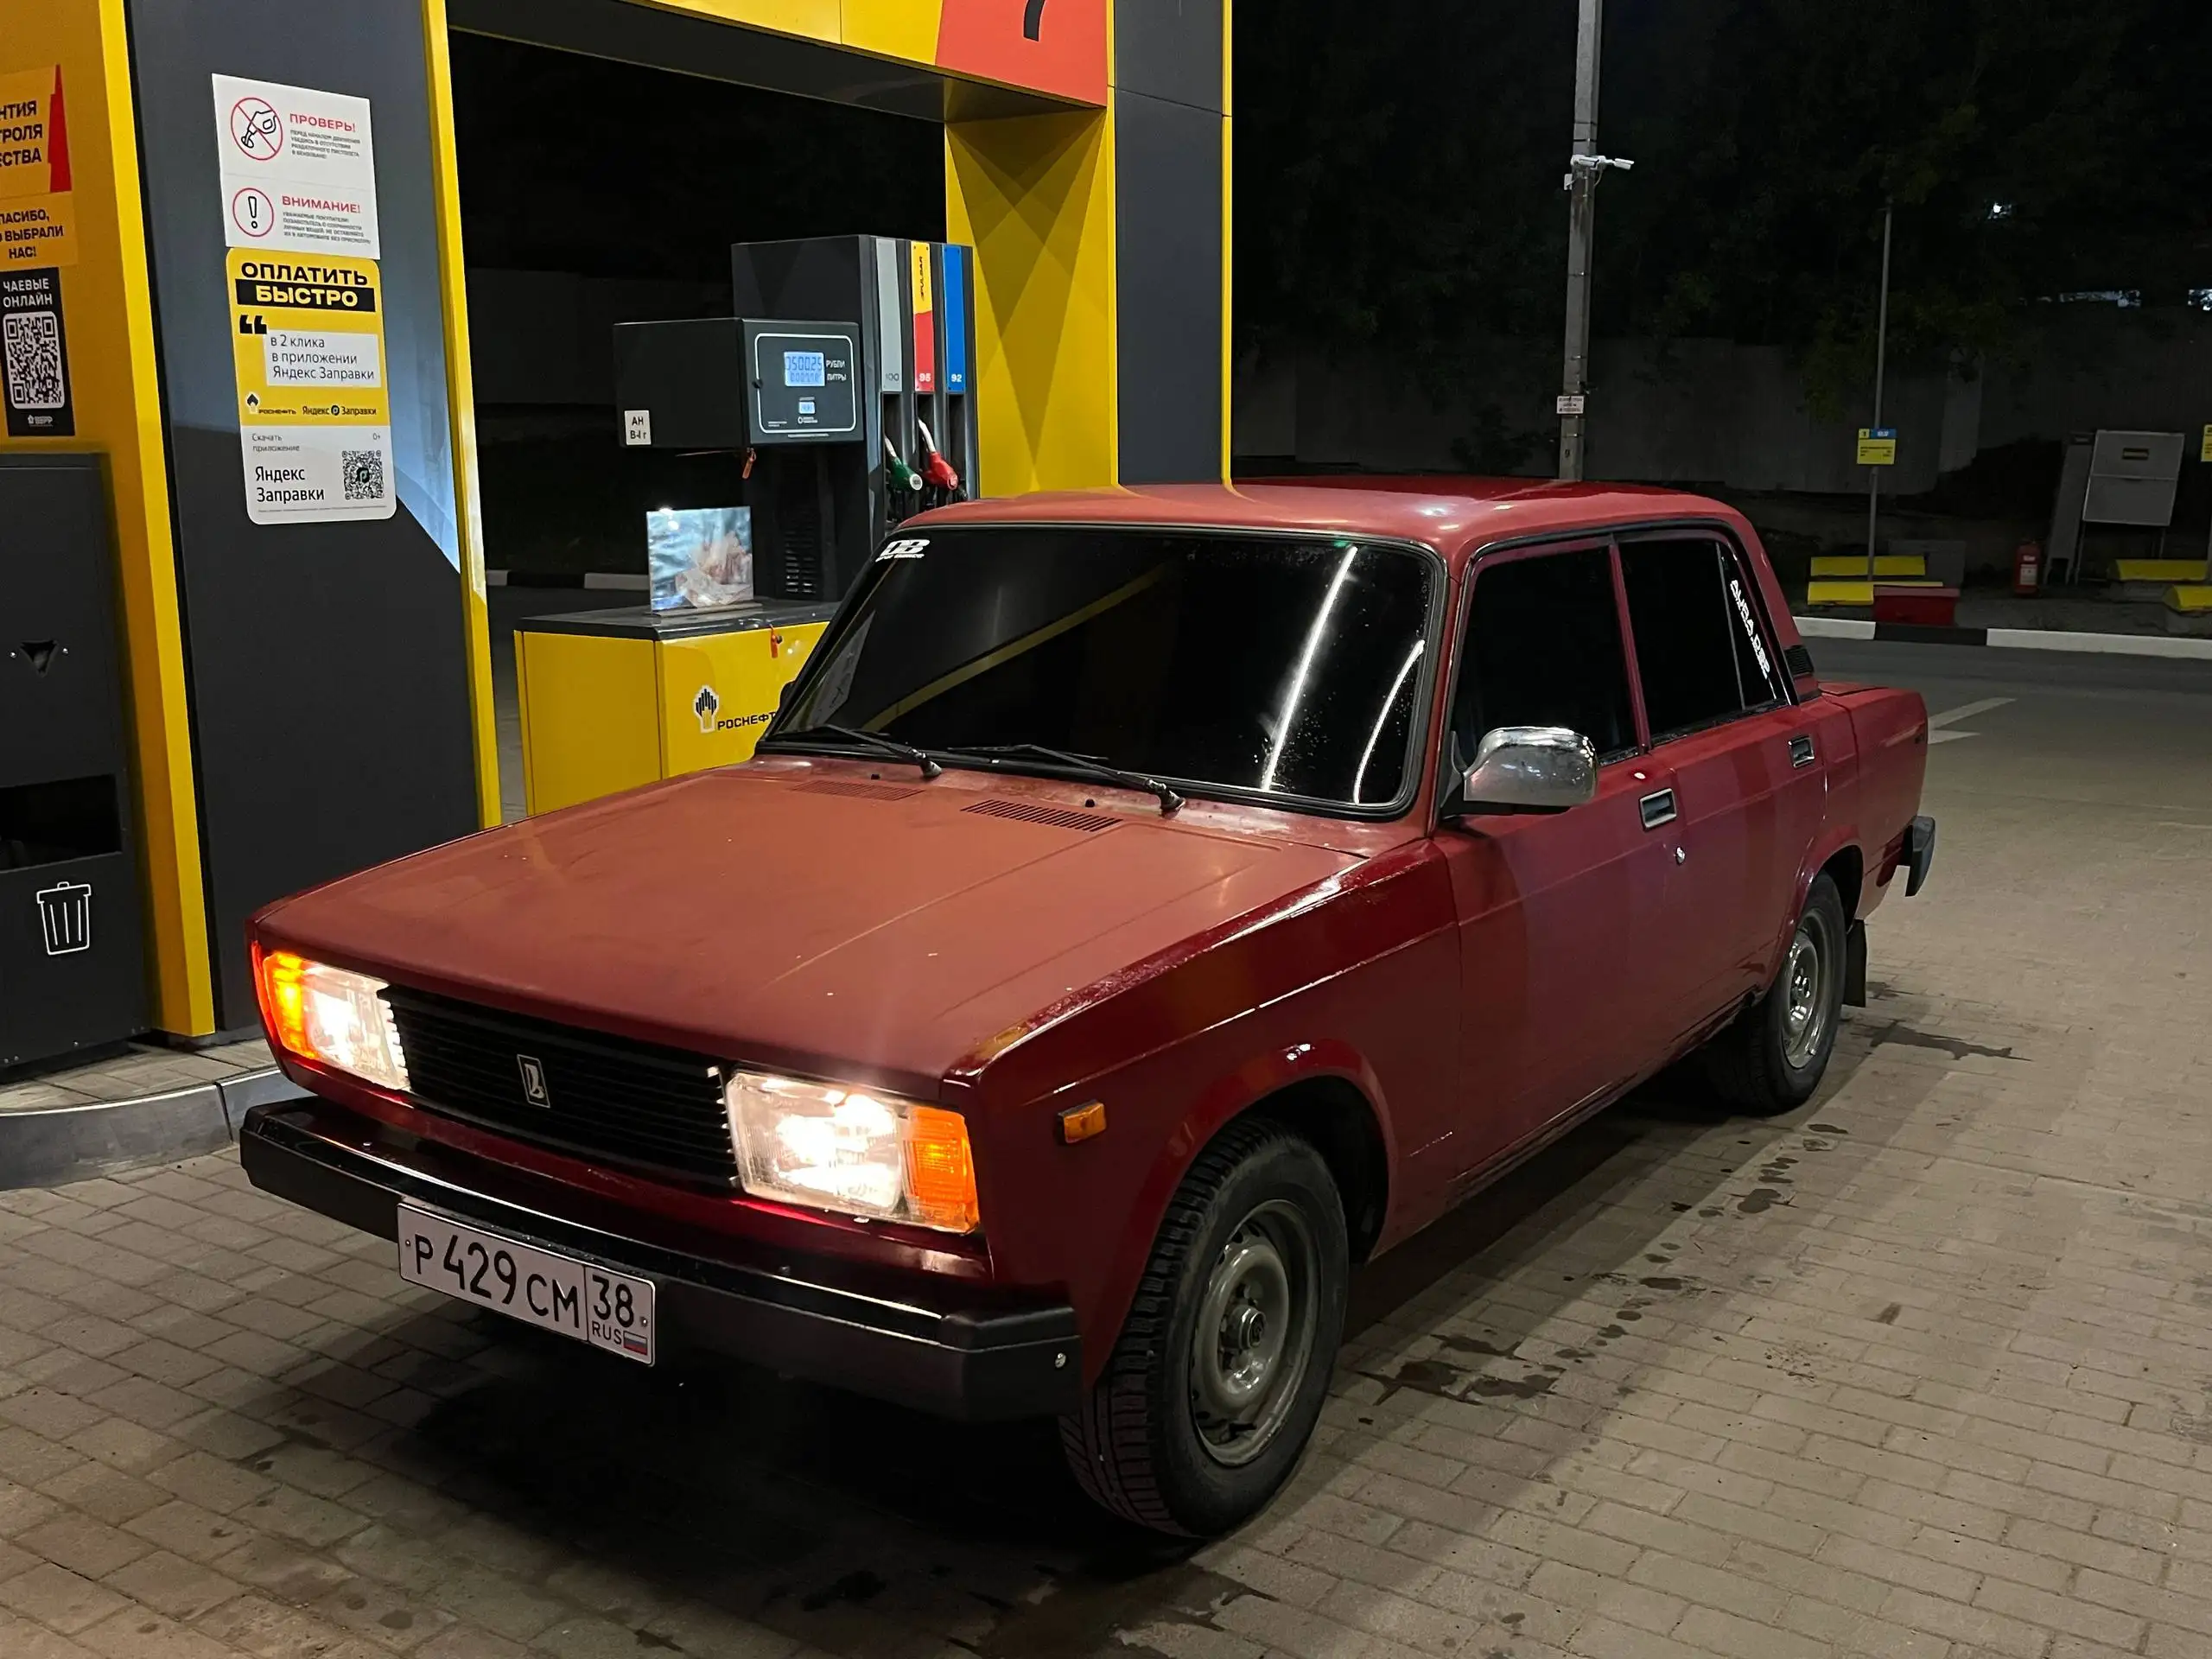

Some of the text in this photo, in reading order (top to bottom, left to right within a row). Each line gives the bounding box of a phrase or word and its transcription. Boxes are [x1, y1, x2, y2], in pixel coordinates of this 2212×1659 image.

[289, 113, 356, 132] ПРОВЕРЬ!
[0, 124, 42, 143] РОЛЯ
[282, 196, 360, 213] ВНИМАНИЕ!
[4, 226, 64, 242] ВЫБРАЛИ
[9, 246, 36, 258] НАС!
[241, 263, 368, 286] ОПЛАТИТЬ
[3, 278, 49, 292] ЧАЕВЫЕ
[3, 291, 53, 308] ОНЛАЙН
[256, 285, 358, 307] БЫСТРО
[270, 334, 325, 348] в 2 клика
[272, 353, 357, 365] в приложении
[273, 365, 374, 382] Яндекс Заправки
[302, 406, 329, 415] Яндекс
[341, 407, 377, 416] Заправки
[632, 416, 644, 425] АН
[255, 467, 305, 483] Яндекс
[257, 487, 324, 504] Заправки
[717, 711, 776, 730] РОСНЕФТ
[592, 1275, 635, 1328] 38
[591, 1320, 622, 1345] RUS
